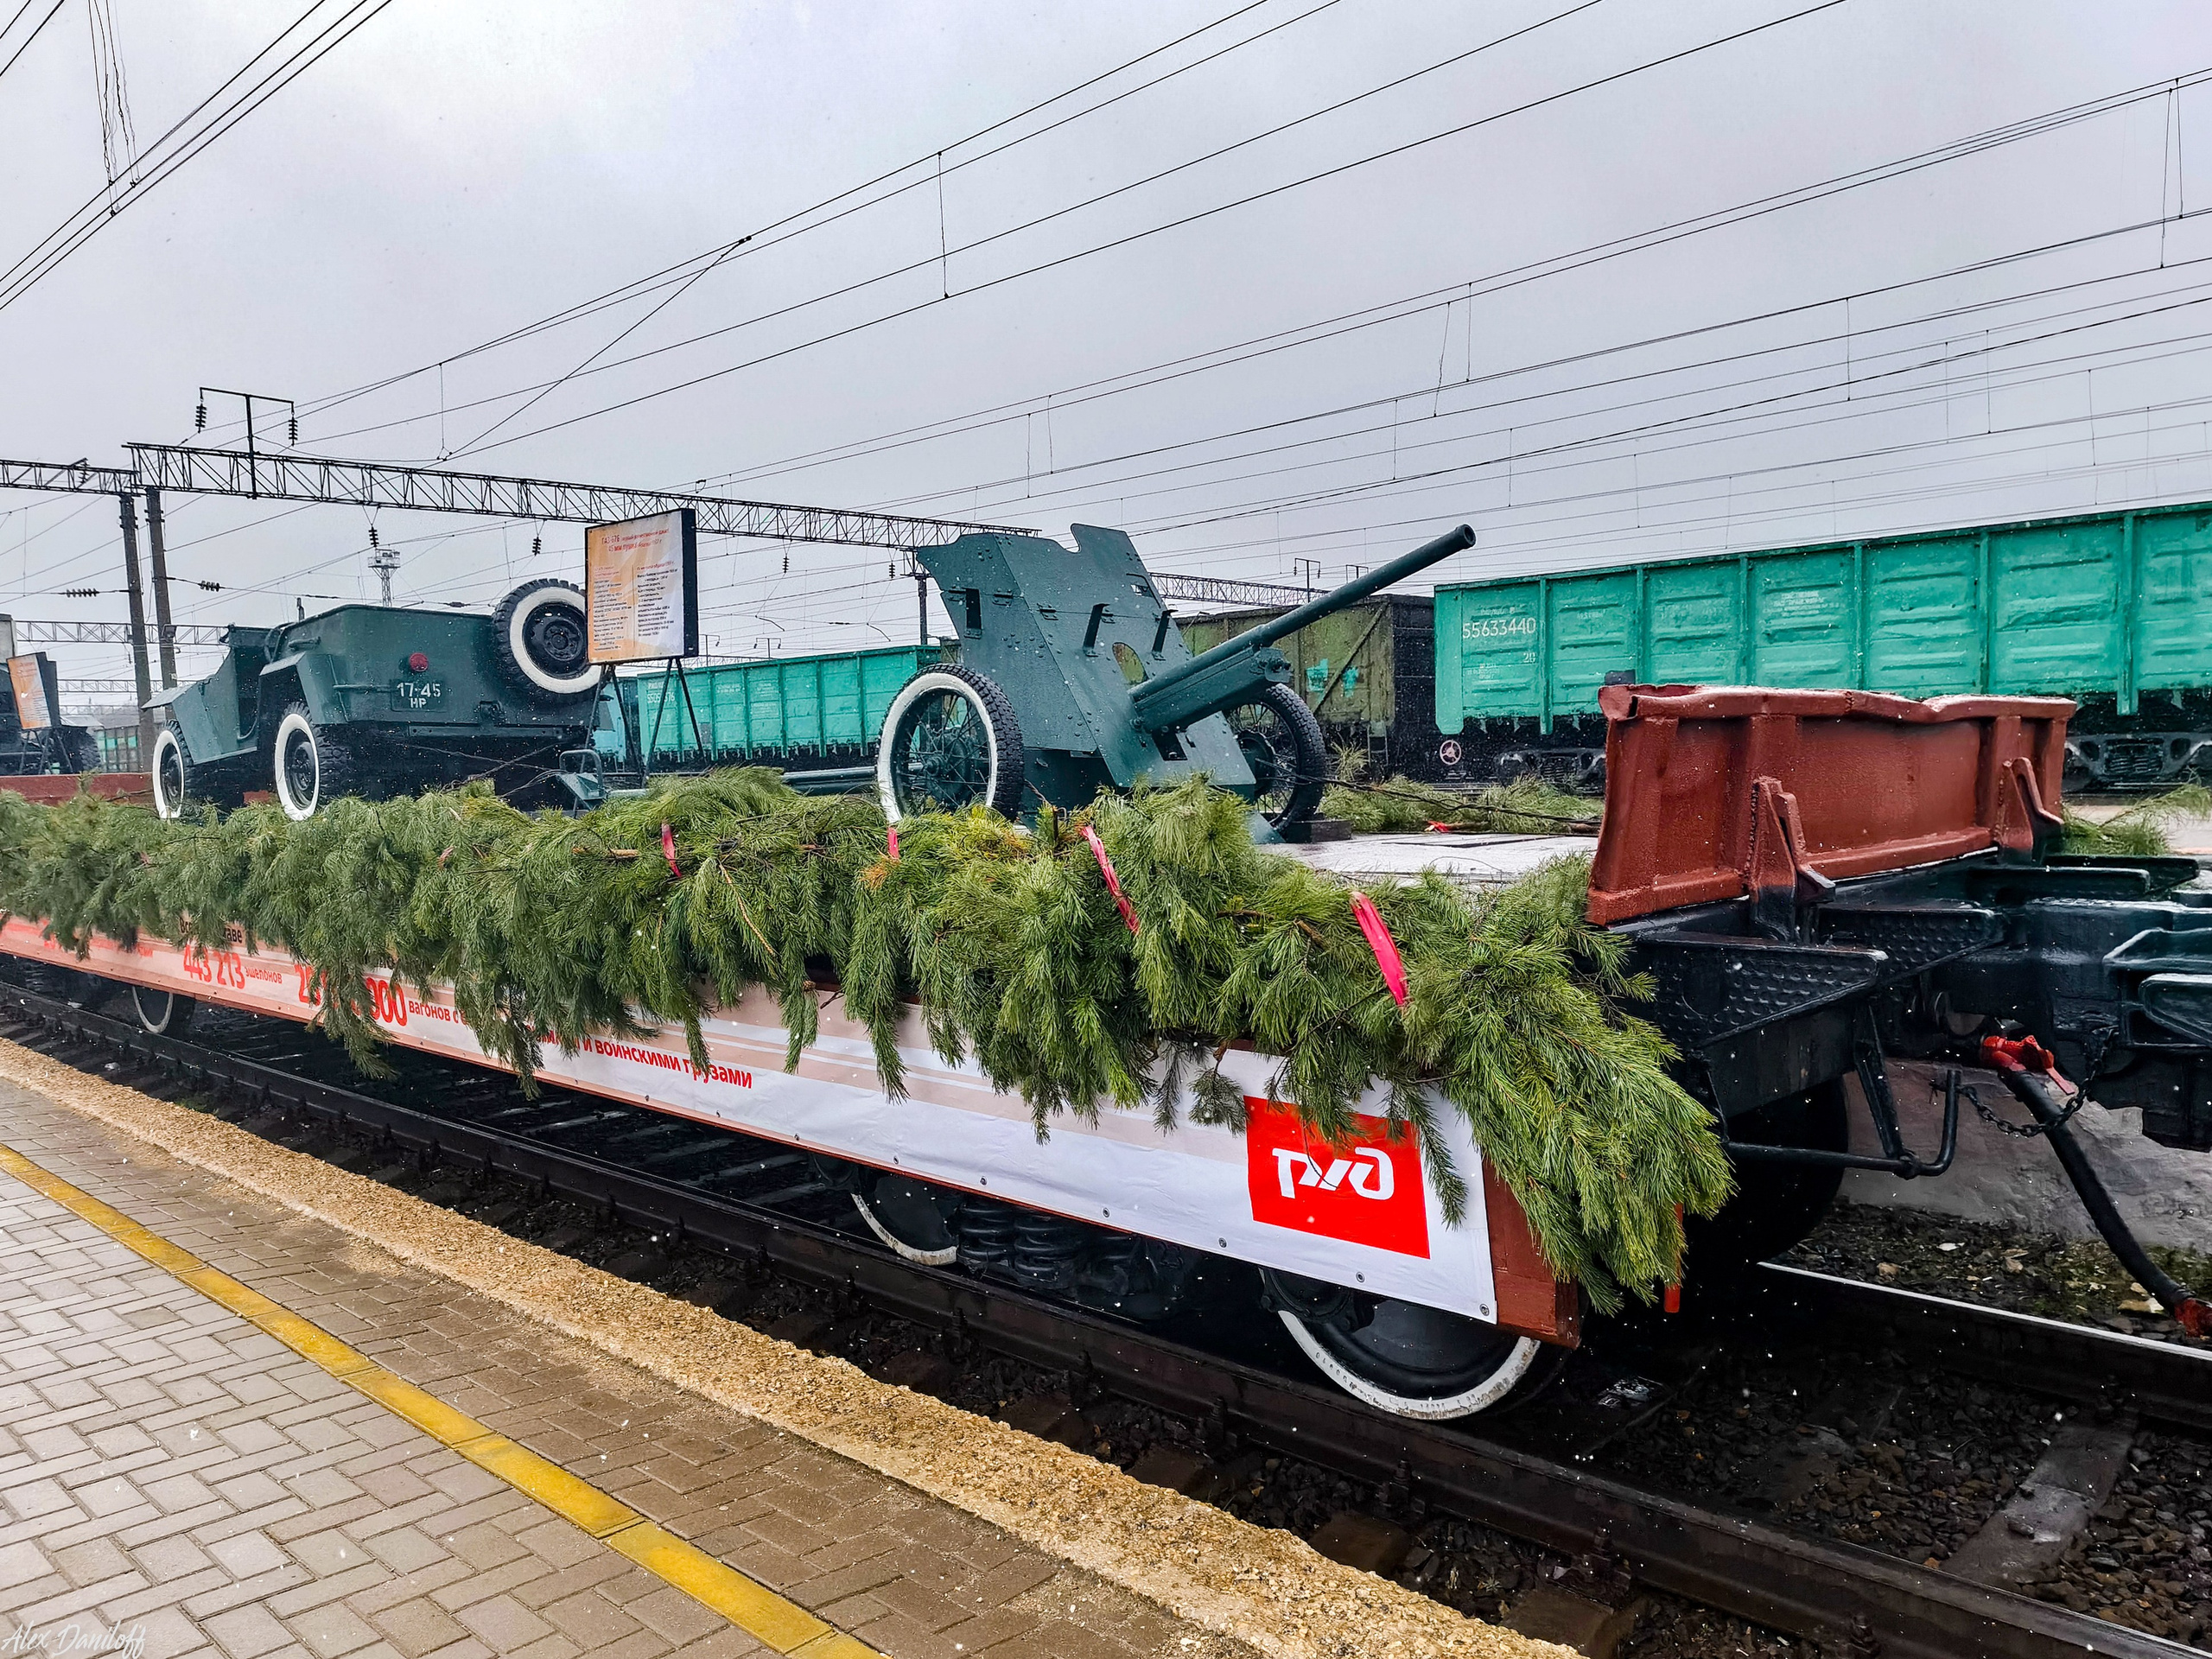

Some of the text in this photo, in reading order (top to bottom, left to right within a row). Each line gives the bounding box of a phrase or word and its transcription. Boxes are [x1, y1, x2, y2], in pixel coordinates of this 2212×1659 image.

[1462, 617, 1536, 639] 55633440
[245, 966, 283, 984] эшелонов
[409, 1000, 451, 1022] вагонов
[594, 1039, 682, 1072] воинскими
